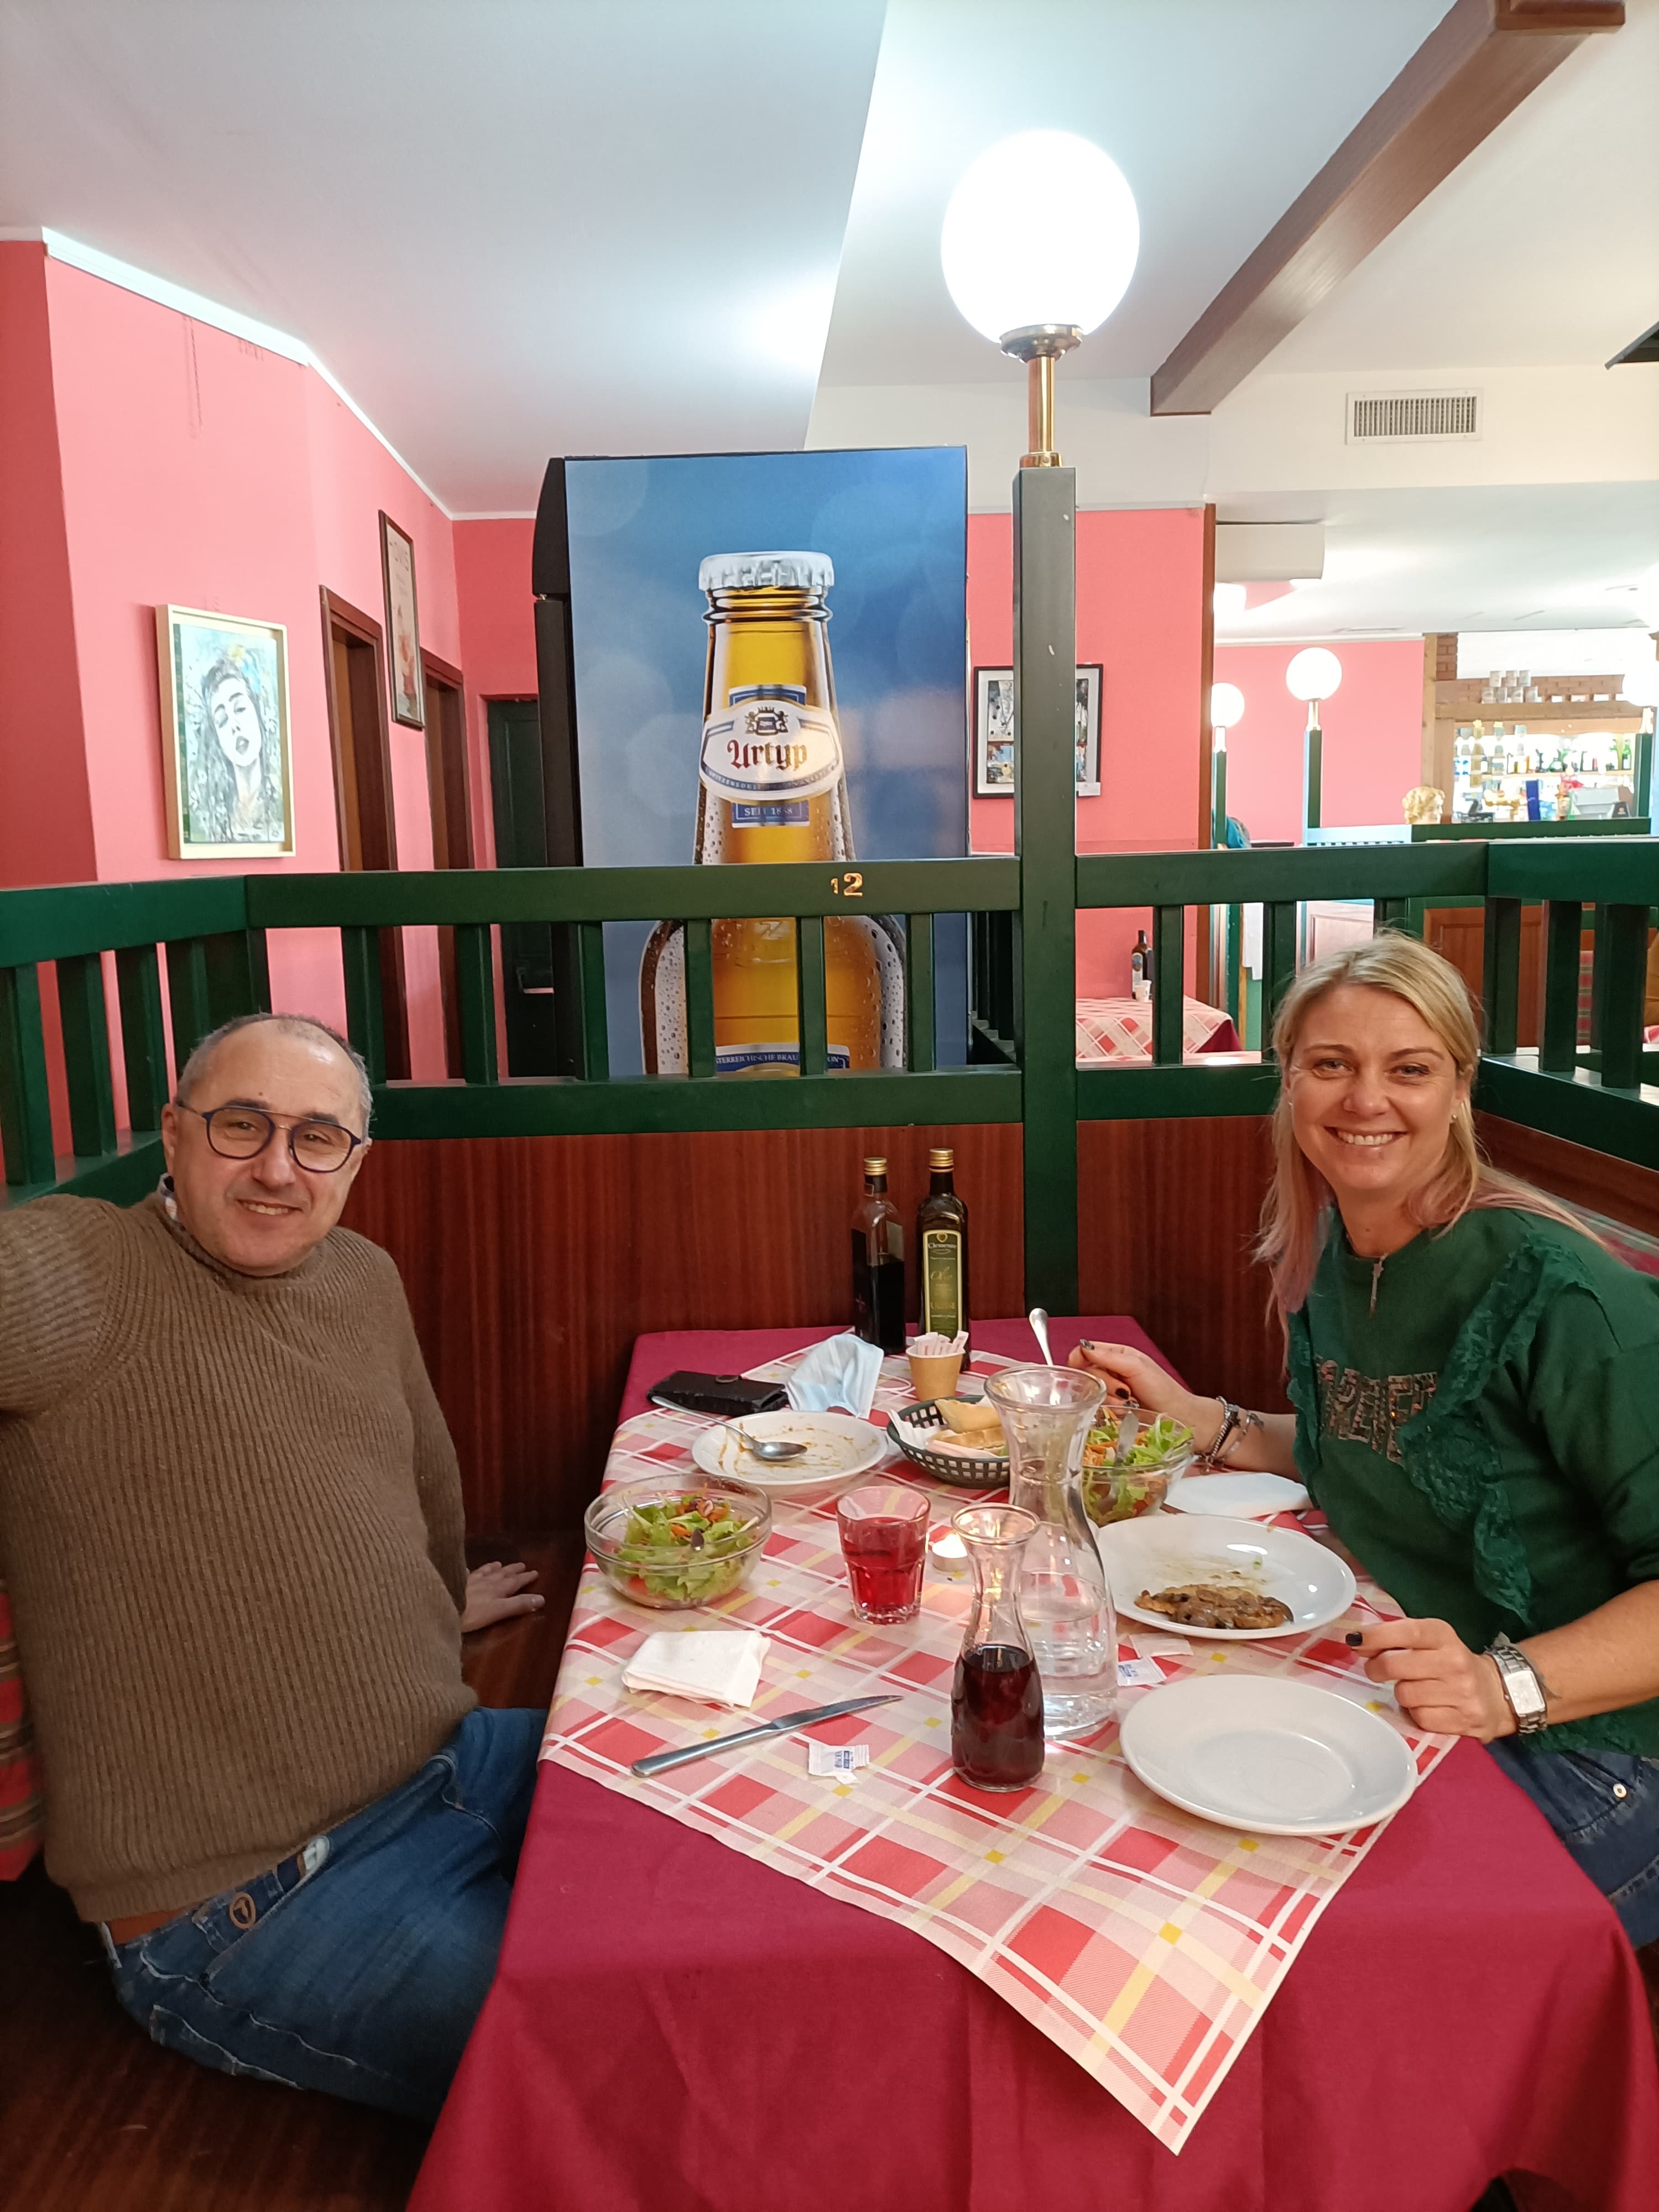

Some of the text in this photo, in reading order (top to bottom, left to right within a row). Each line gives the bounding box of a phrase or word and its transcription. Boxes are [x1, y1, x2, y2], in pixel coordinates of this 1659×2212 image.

[727, 739, 807, 771] Urtyp
[830, 872, 863, 897] 12
[715, 1054, 775, 1064] STERREICHISCHE
